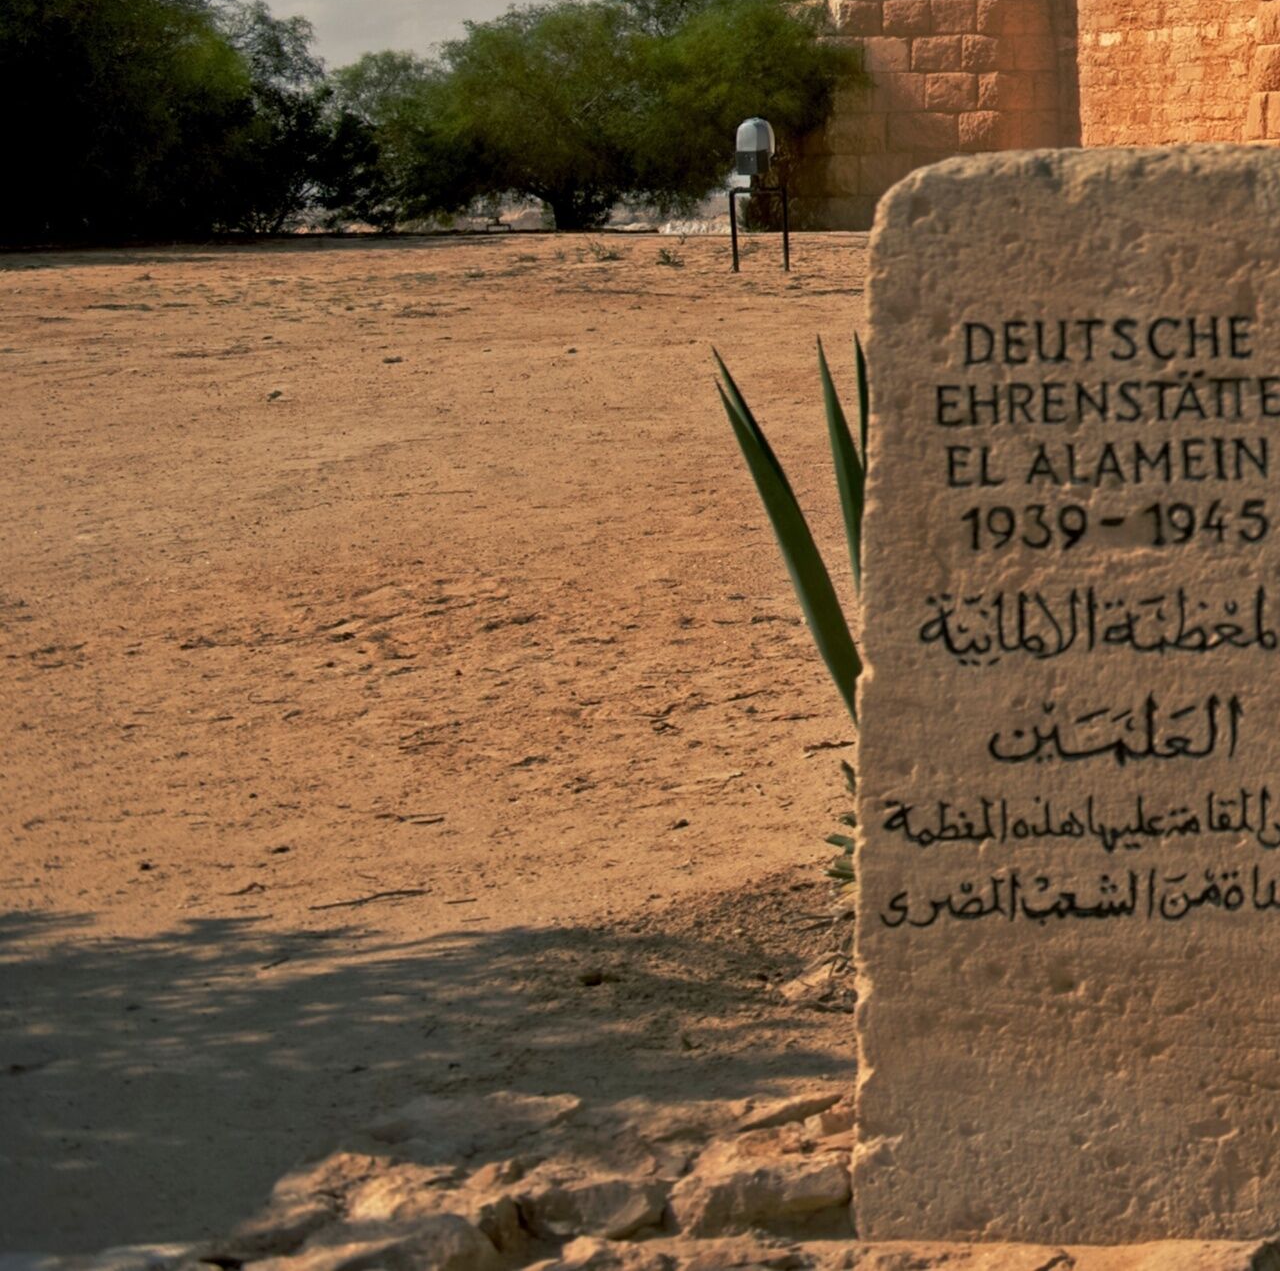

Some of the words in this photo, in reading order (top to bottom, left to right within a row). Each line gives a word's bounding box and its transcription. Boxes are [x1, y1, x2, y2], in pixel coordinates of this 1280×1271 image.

[962, 314, 1254, 366] DEUTSCHE
[945, 444, 1004, 488] EL
[1024, 436, 1269, 485] ALAMEIN
